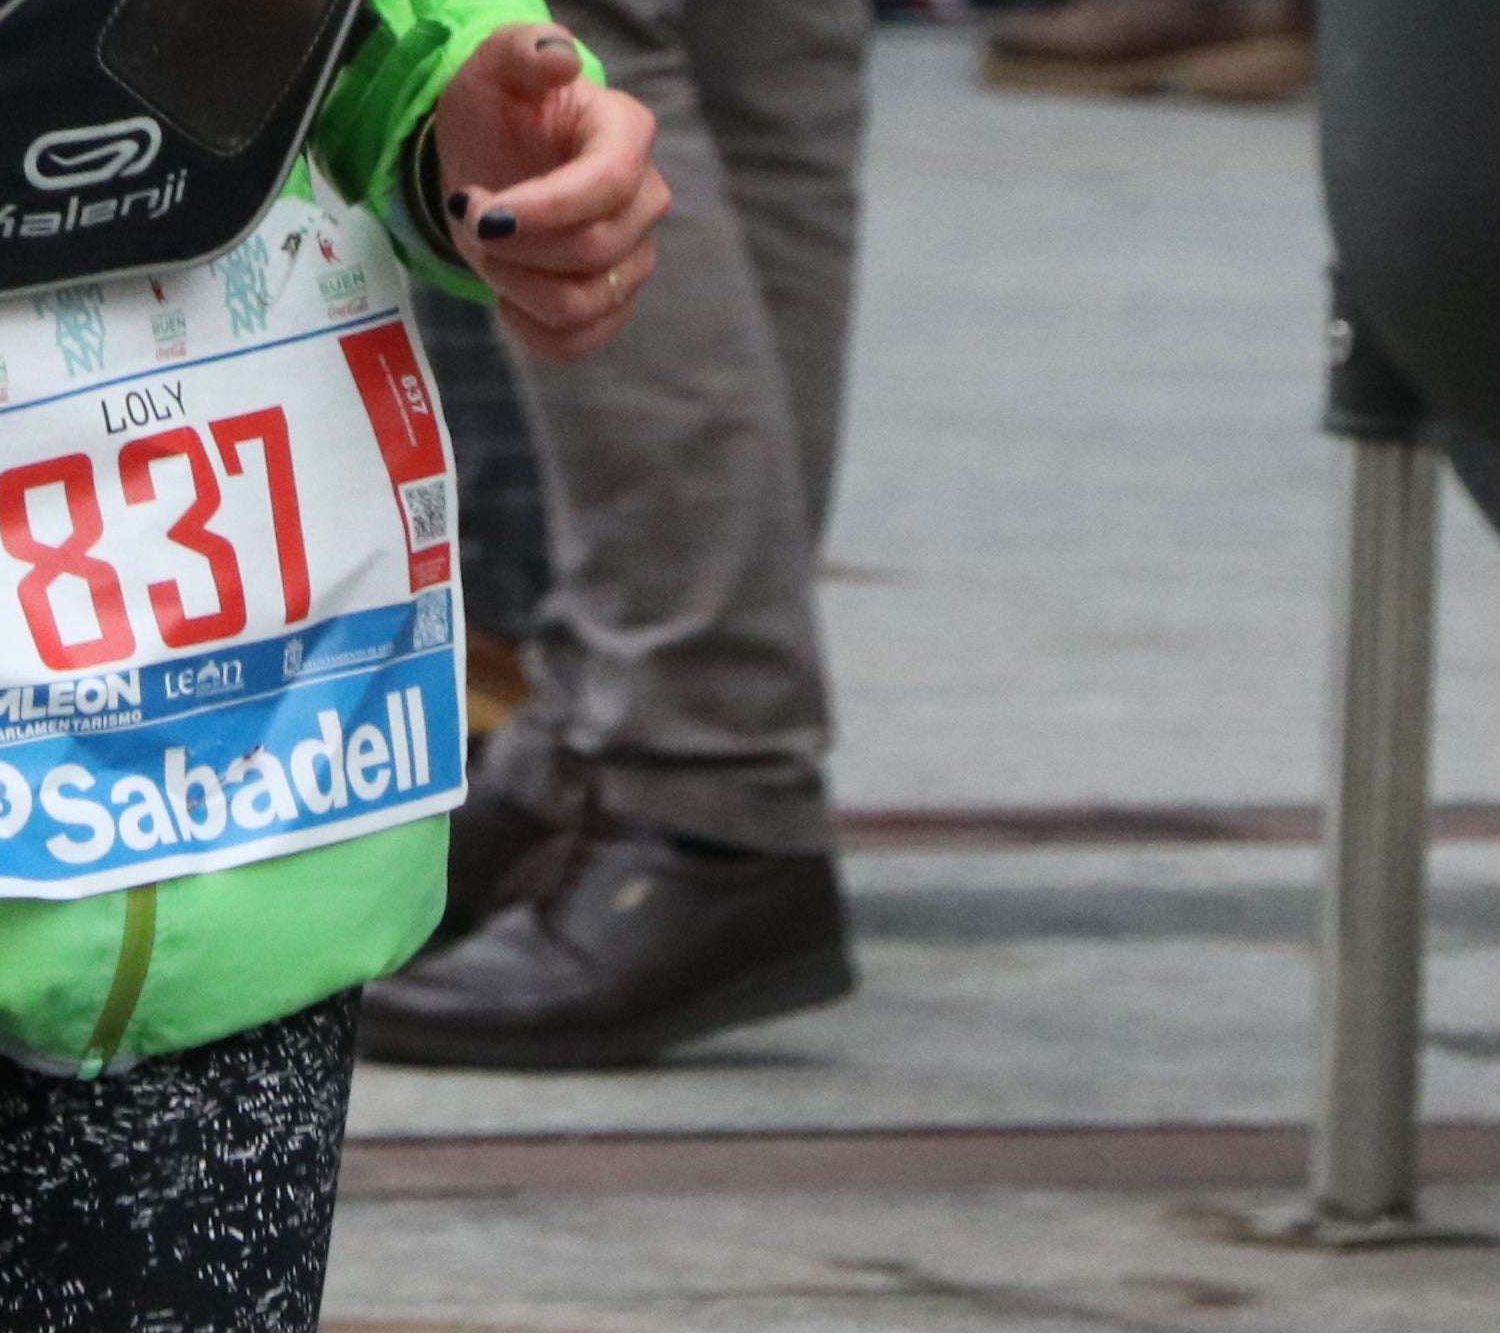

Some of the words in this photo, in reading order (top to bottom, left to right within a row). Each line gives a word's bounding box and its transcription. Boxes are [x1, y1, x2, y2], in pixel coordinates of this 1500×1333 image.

[101, 380, 188, 435] LOLY
[401, 374, 430, 416] 837
[38, 685, 431, 864] Sabadell
